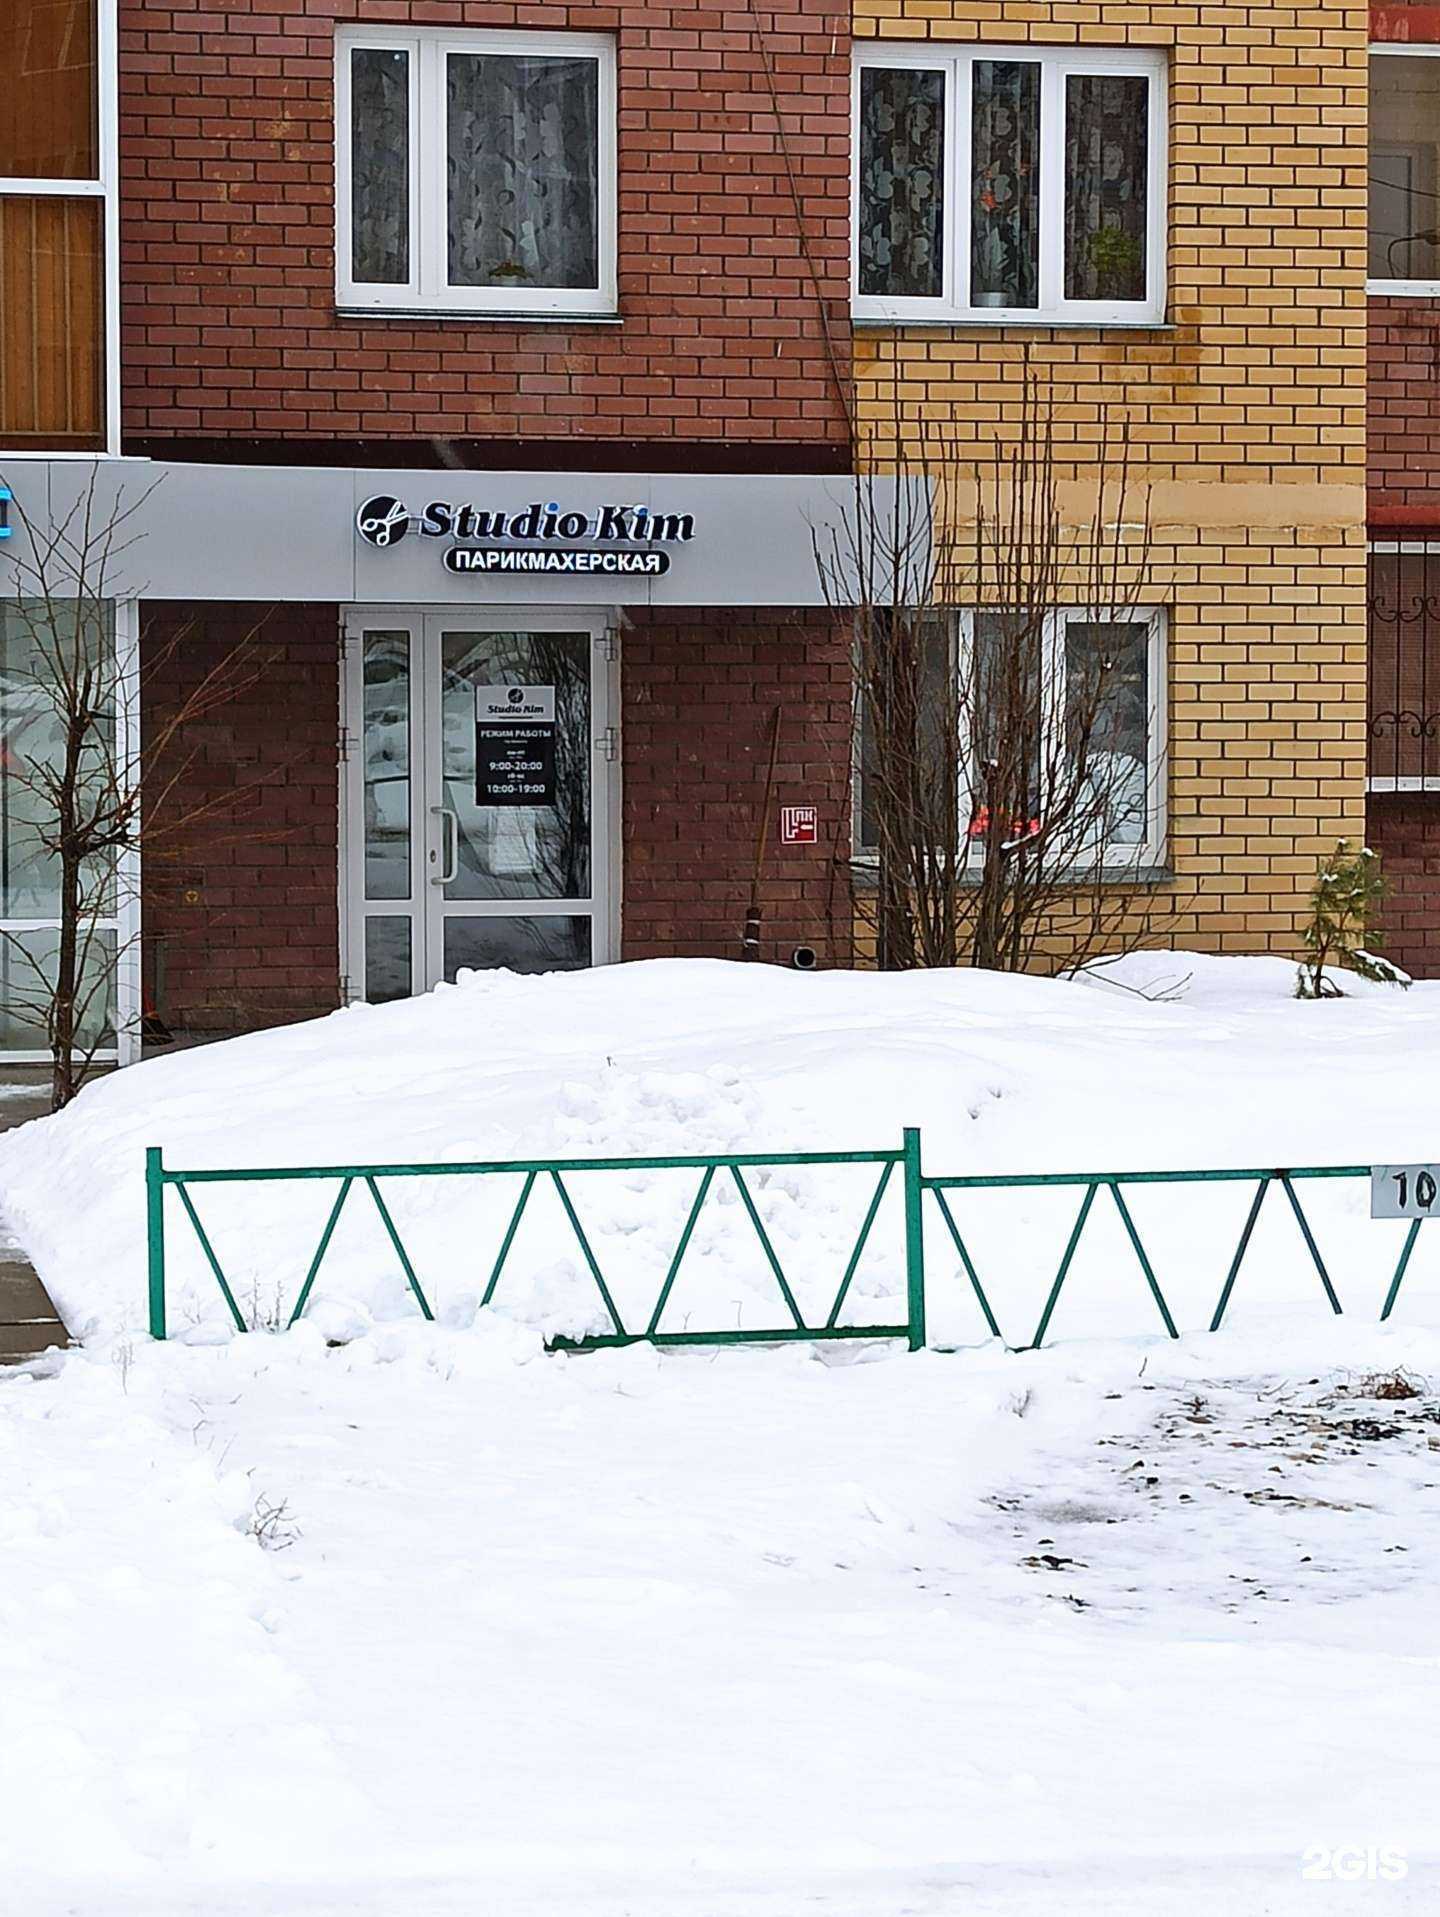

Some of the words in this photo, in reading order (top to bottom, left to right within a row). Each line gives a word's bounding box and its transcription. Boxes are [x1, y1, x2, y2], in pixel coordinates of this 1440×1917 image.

[419, 501, 590, 541] Studio
[592, 505, 696, 542] Kim
[455, 550, 661, 573] ПАРИКМАХЕРСКАЯ
[487, 704, 522, 714] Studio
[480, 729, 514, 738] РЕЖИМ
[515, 729, 552, 738] РАБОТЫ
[489, 761, 543, 771] 9:00-20:00
[487, 784, 546, 793] 10:00-19:00
[1391, 1171, 1438, 1210] 10
